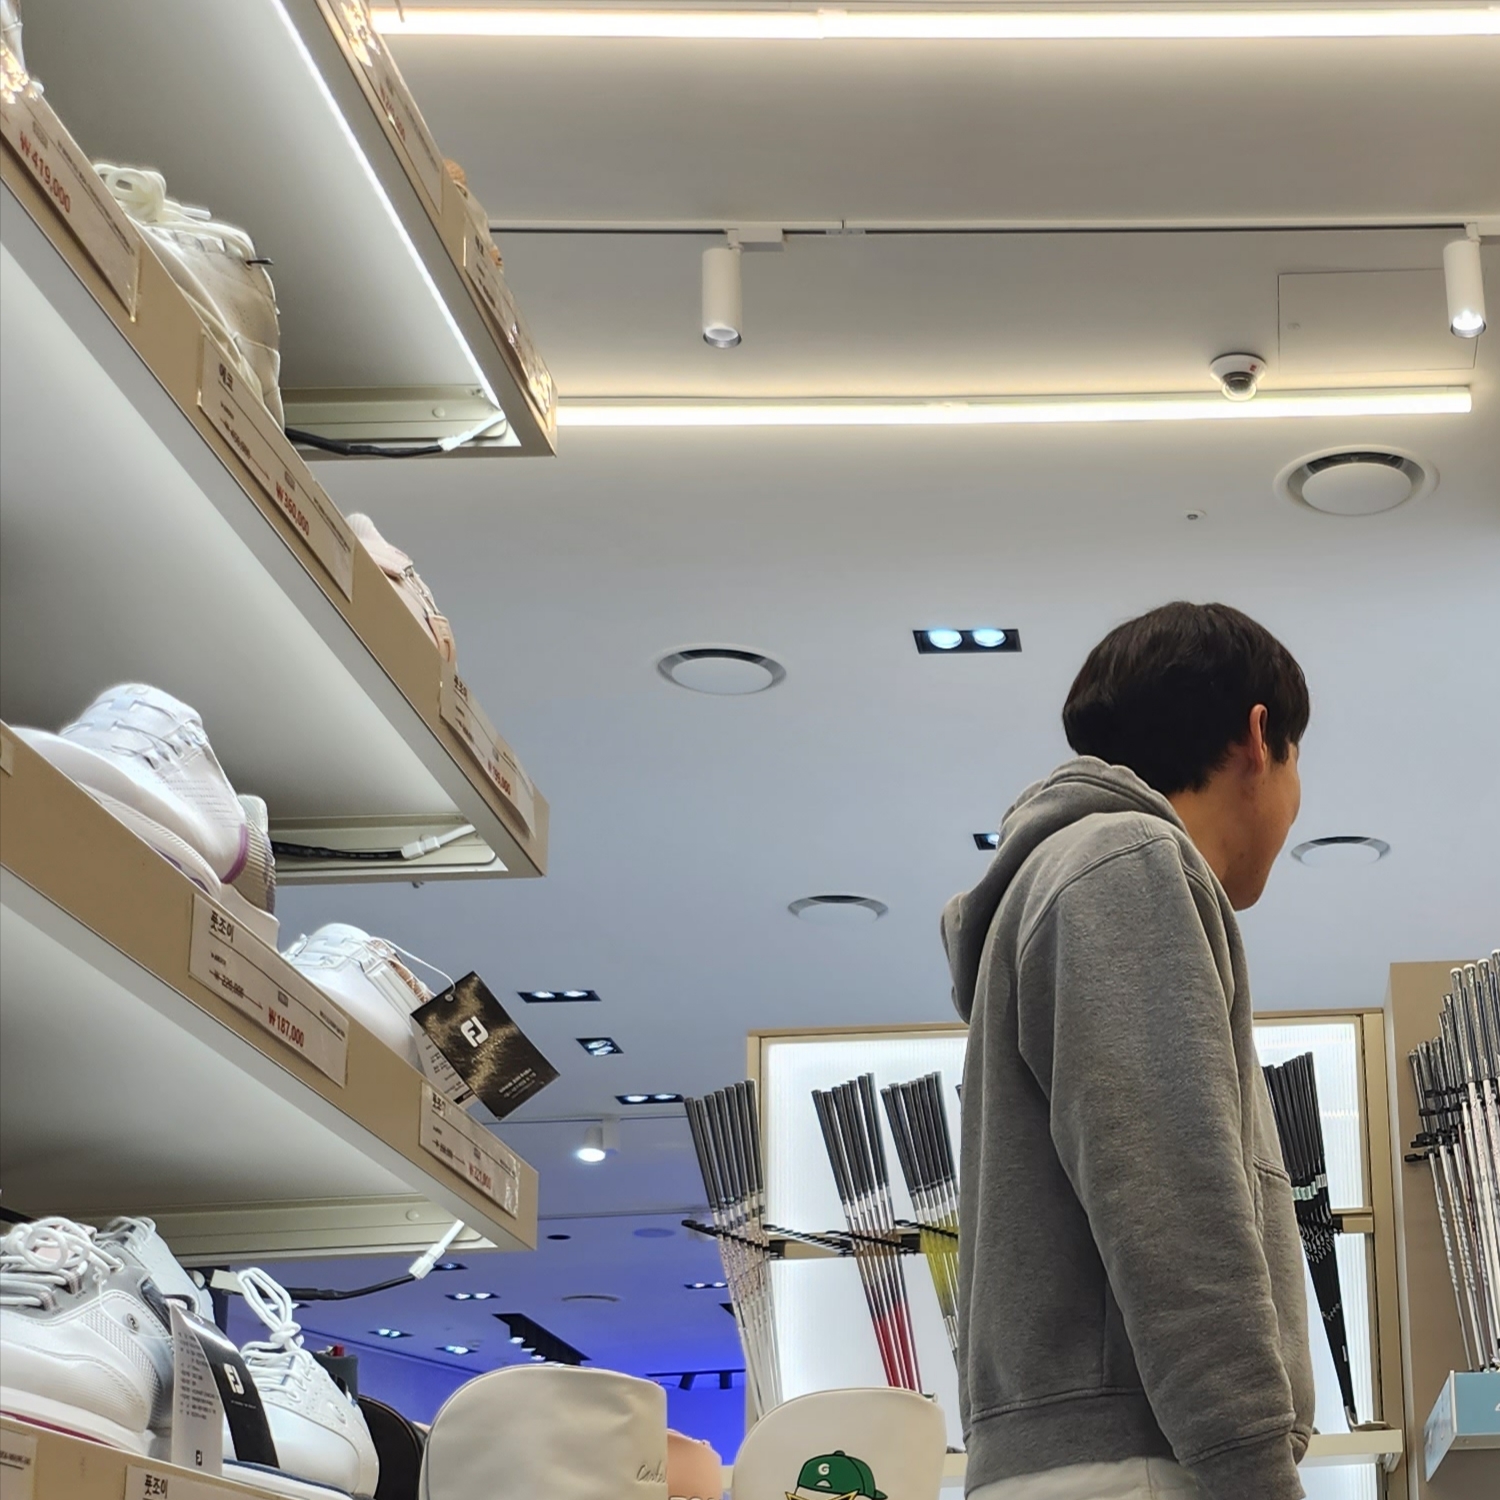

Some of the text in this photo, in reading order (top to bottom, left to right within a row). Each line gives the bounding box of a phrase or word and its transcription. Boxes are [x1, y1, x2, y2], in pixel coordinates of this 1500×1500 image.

[209, 910, 235, 943] 풋조이
[268, 1006, 305, 1048] ₩187,000
[460, 1015, 489, 1048] FJ
[144, 1473, 169, 1500] 풋조이
